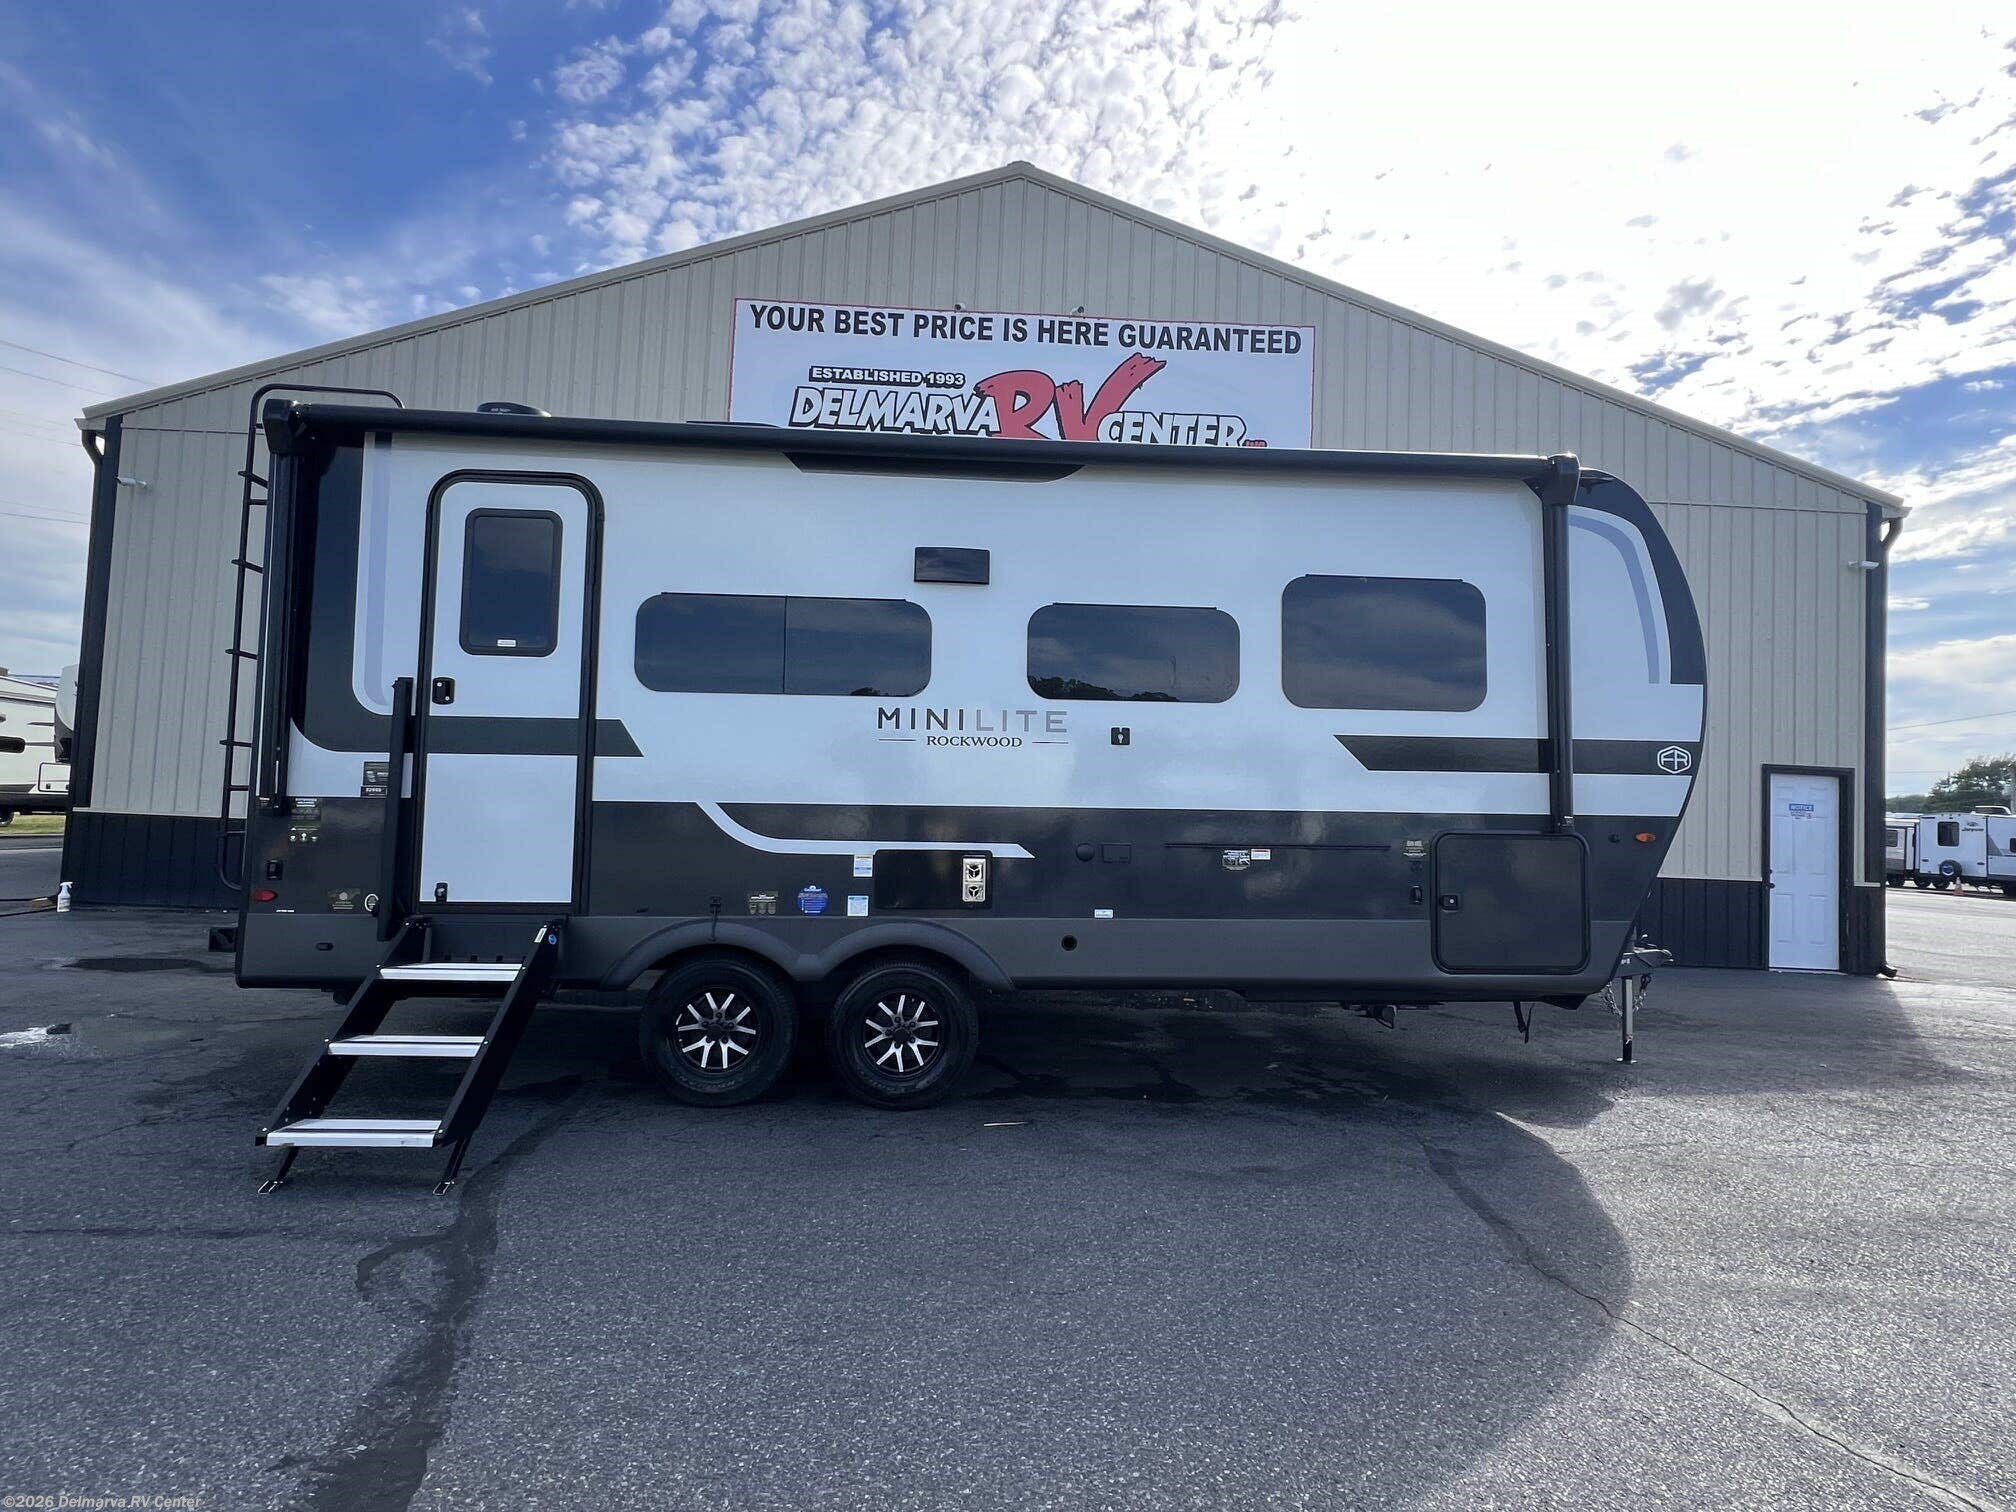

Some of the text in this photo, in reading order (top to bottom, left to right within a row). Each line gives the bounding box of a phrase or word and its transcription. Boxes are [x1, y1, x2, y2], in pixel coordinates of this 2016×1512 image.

[750, 304, 1302, 354] YOUR BEST PRICE IS HERE GUARANTEED
[810, 366, 966, 388] ESTABLISHED 1993
[788, 352, 1247, 447] DELMARVA RV CENTER
[926, 735, 1023, 748] ROCKWOOD
